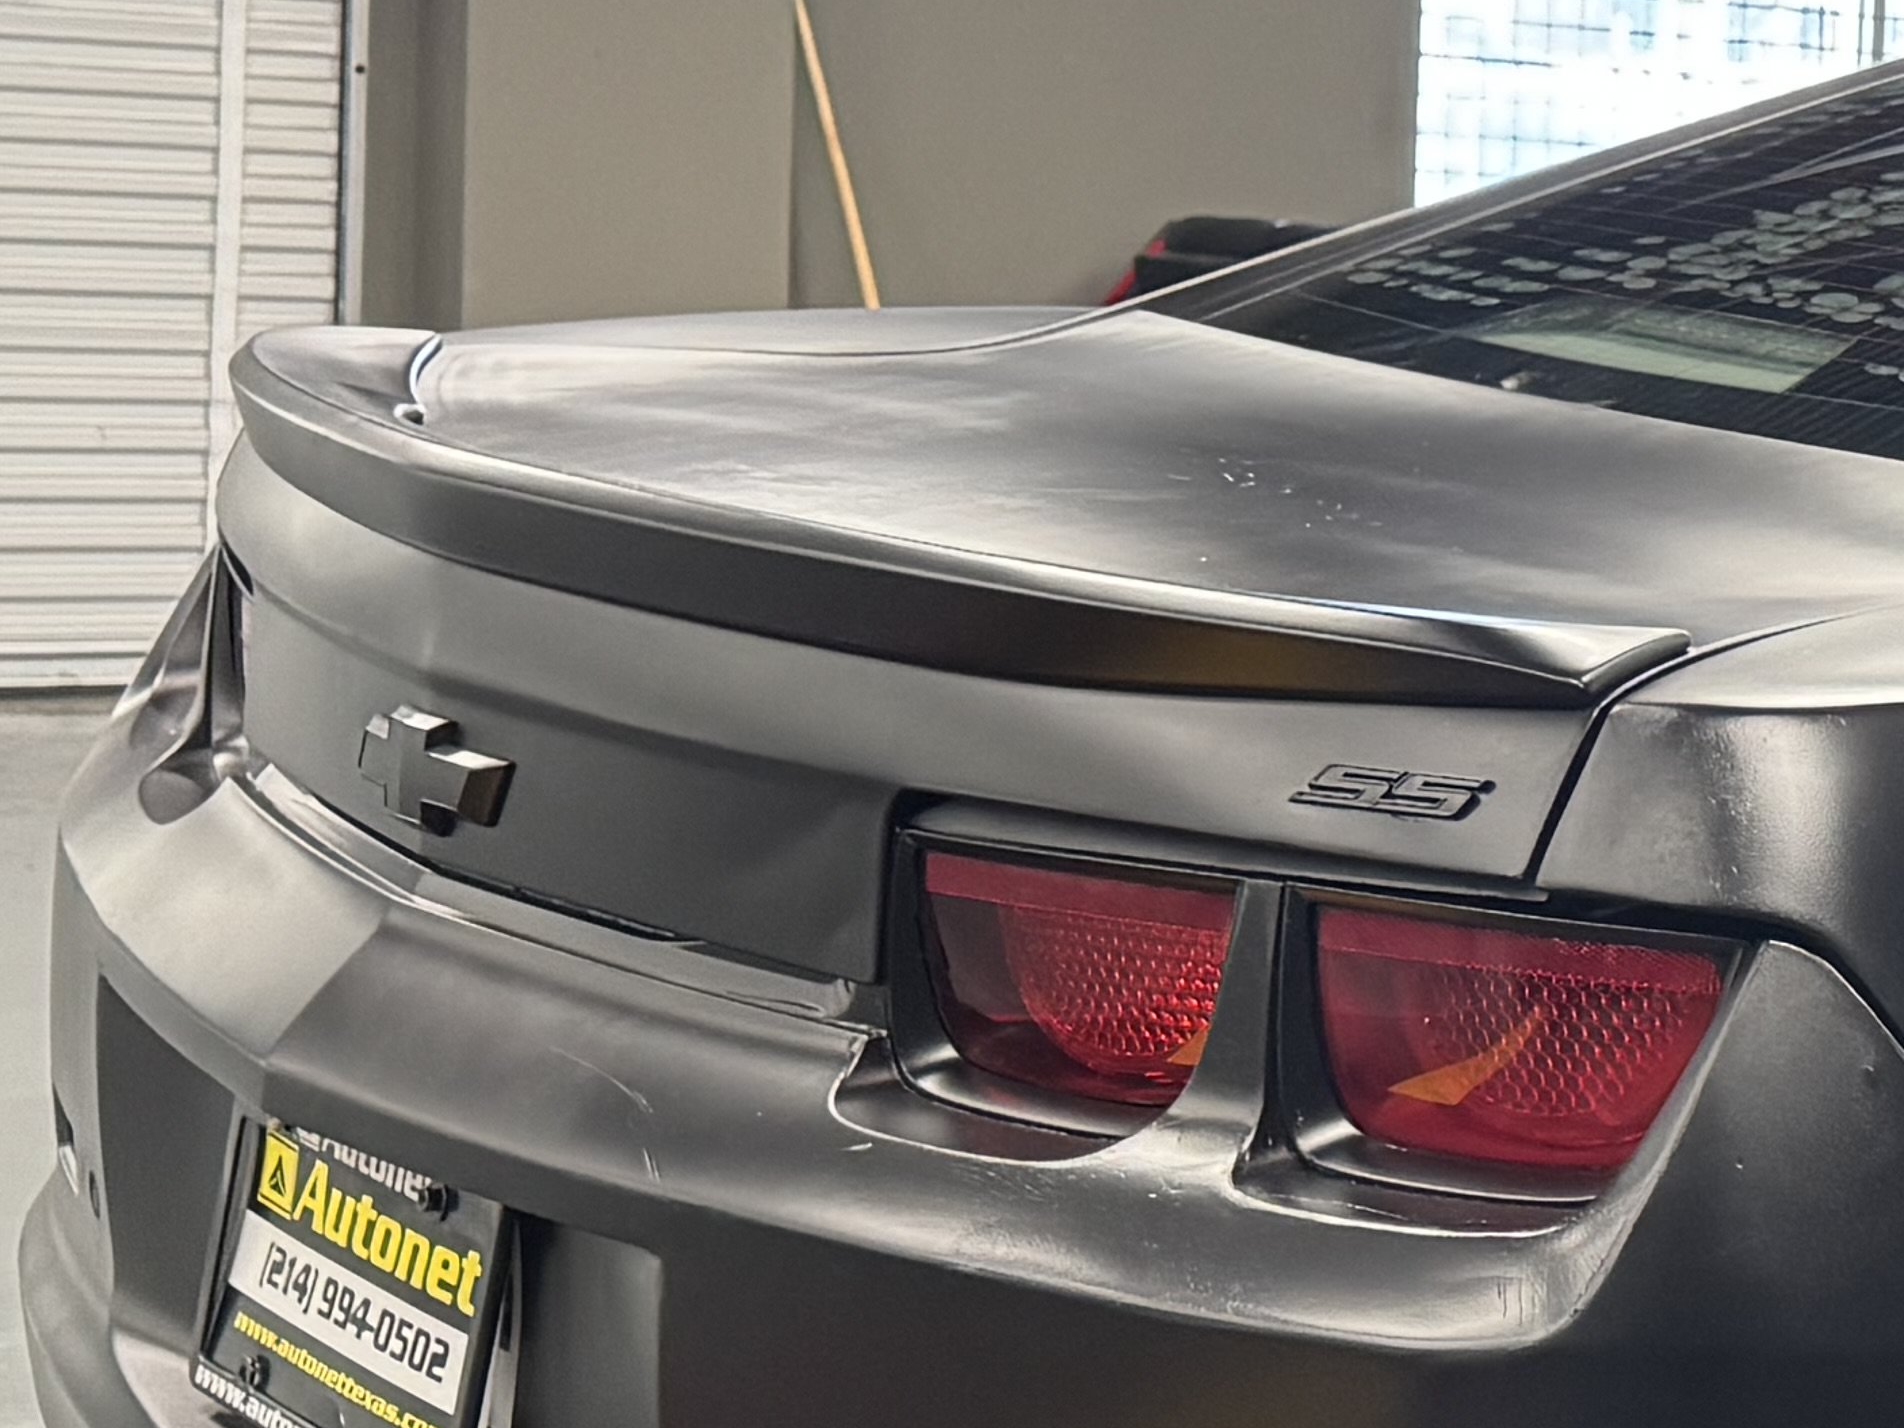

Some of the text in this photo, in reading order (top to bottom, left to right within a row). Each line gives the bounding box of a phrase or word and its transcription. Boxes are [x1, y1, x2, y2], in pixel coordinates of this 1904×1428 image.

[1288, 764, 1496, 820] SS
[293, 1159, 482, 1317] Autonet
[259, 1241, 450, 1384] (214) 994-0502
